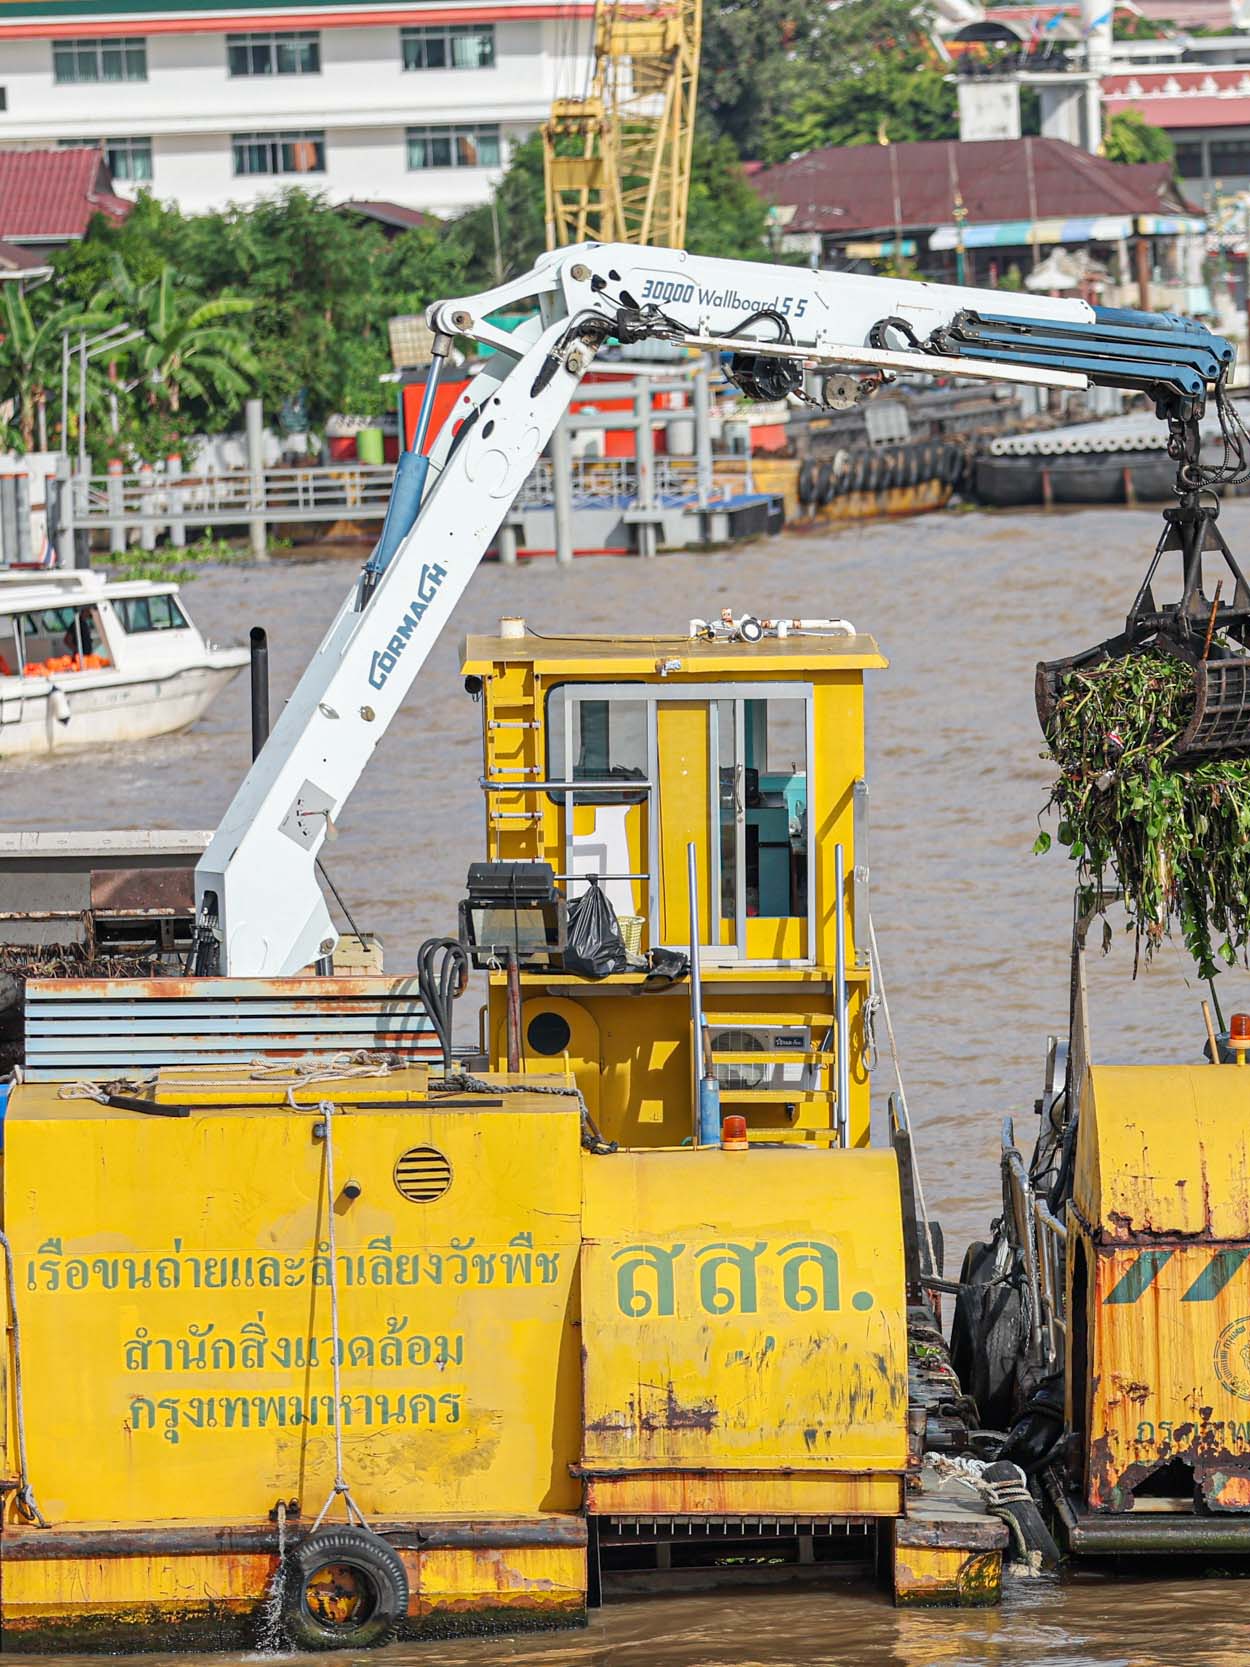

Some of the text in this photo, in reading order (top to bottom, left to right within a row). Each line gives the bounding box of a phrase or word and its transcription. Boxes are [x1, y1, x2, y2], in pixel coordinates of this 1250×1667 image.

[641, 279, 695, 303] 30000
[699, 288, 779, 312] Wallboard
[368, 563, 448, 690] CORMACH
[27, 1231, 560, 1291] เรือขนถ่ายและลำเลียงวัชพืช
[610, 1241, 874, 1318] สสล.
[124, 1311, 464, 1372] สำนักสิ่งแวดล้อม
[128, 1390, 461, 1444] กรุงเทพมหานคร
